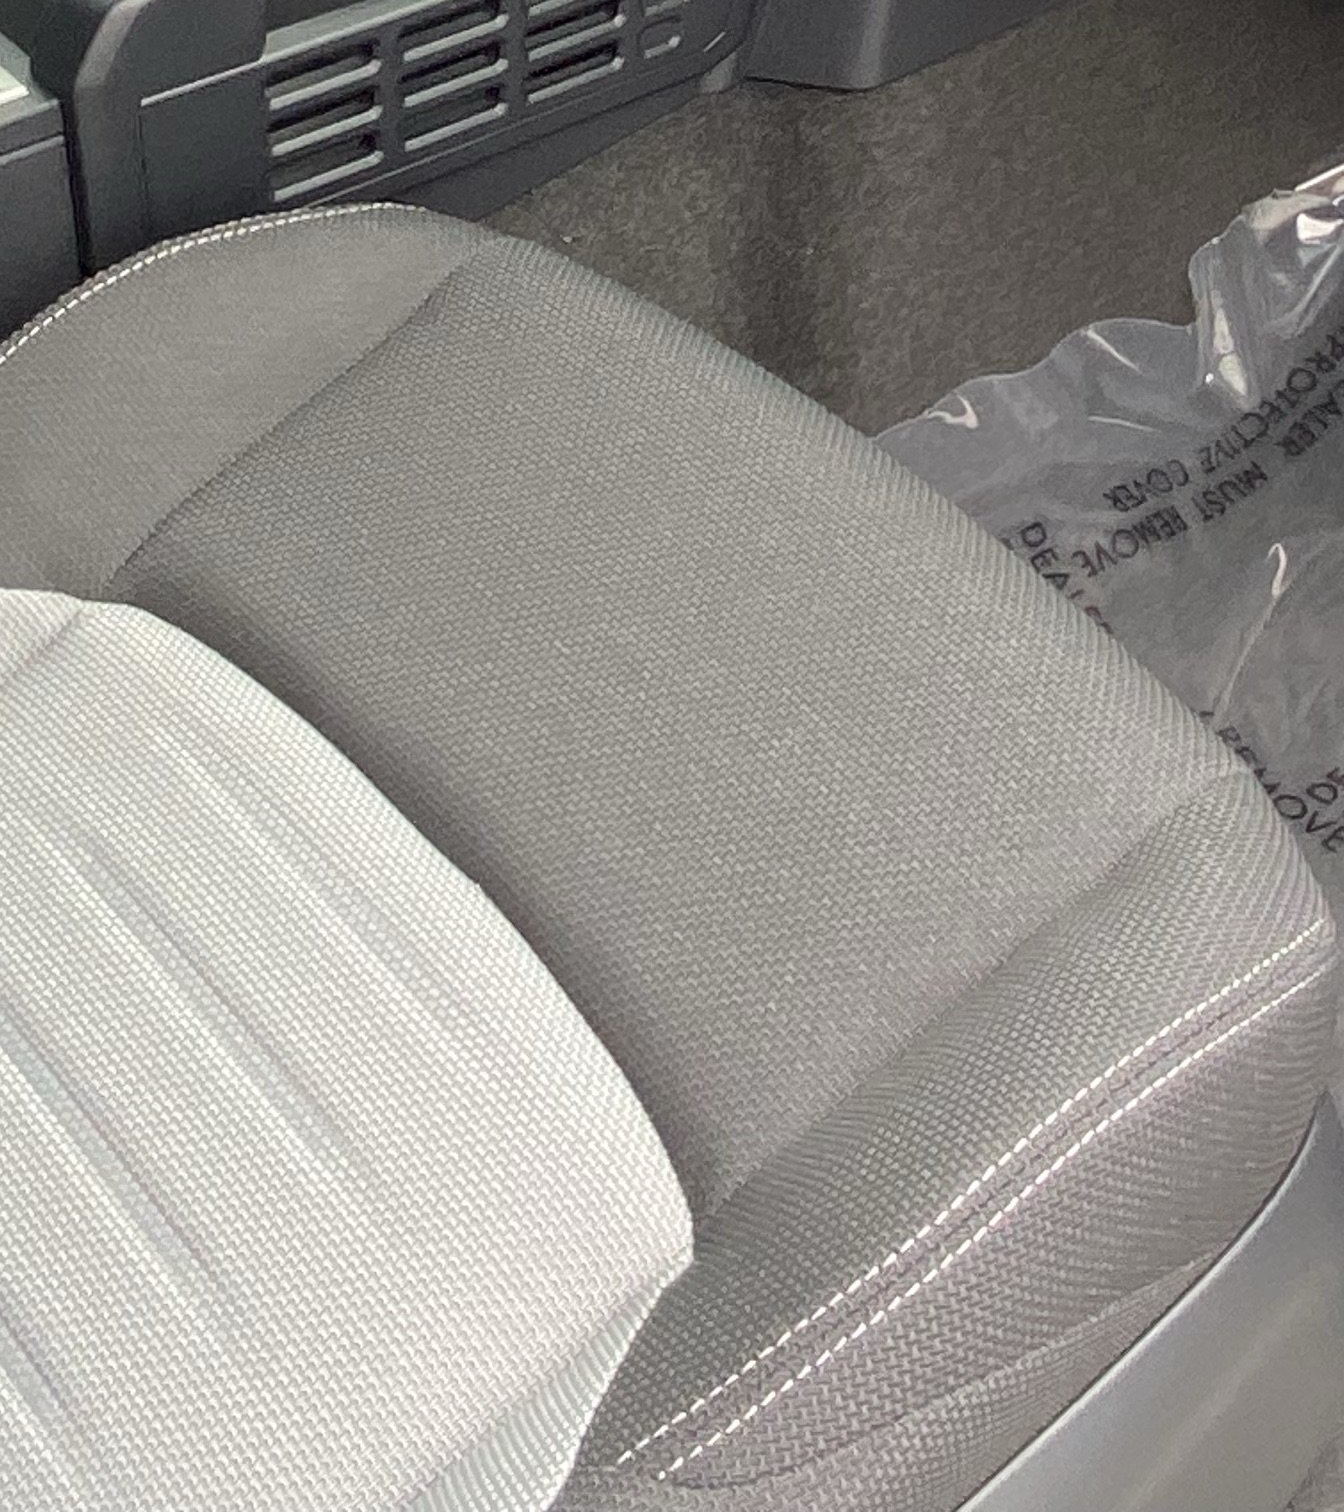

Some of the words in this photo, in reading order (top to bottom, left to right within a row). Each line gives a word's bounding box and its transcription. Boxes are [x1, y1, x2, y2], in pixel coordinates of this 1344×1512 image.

[1102, 458, 1189, 513] COVER
[1191, 460, 1268, 522] MUST
[1070, 504, 1188, 578] REMOVE
[1020, 521, 1114, 633] DEA
